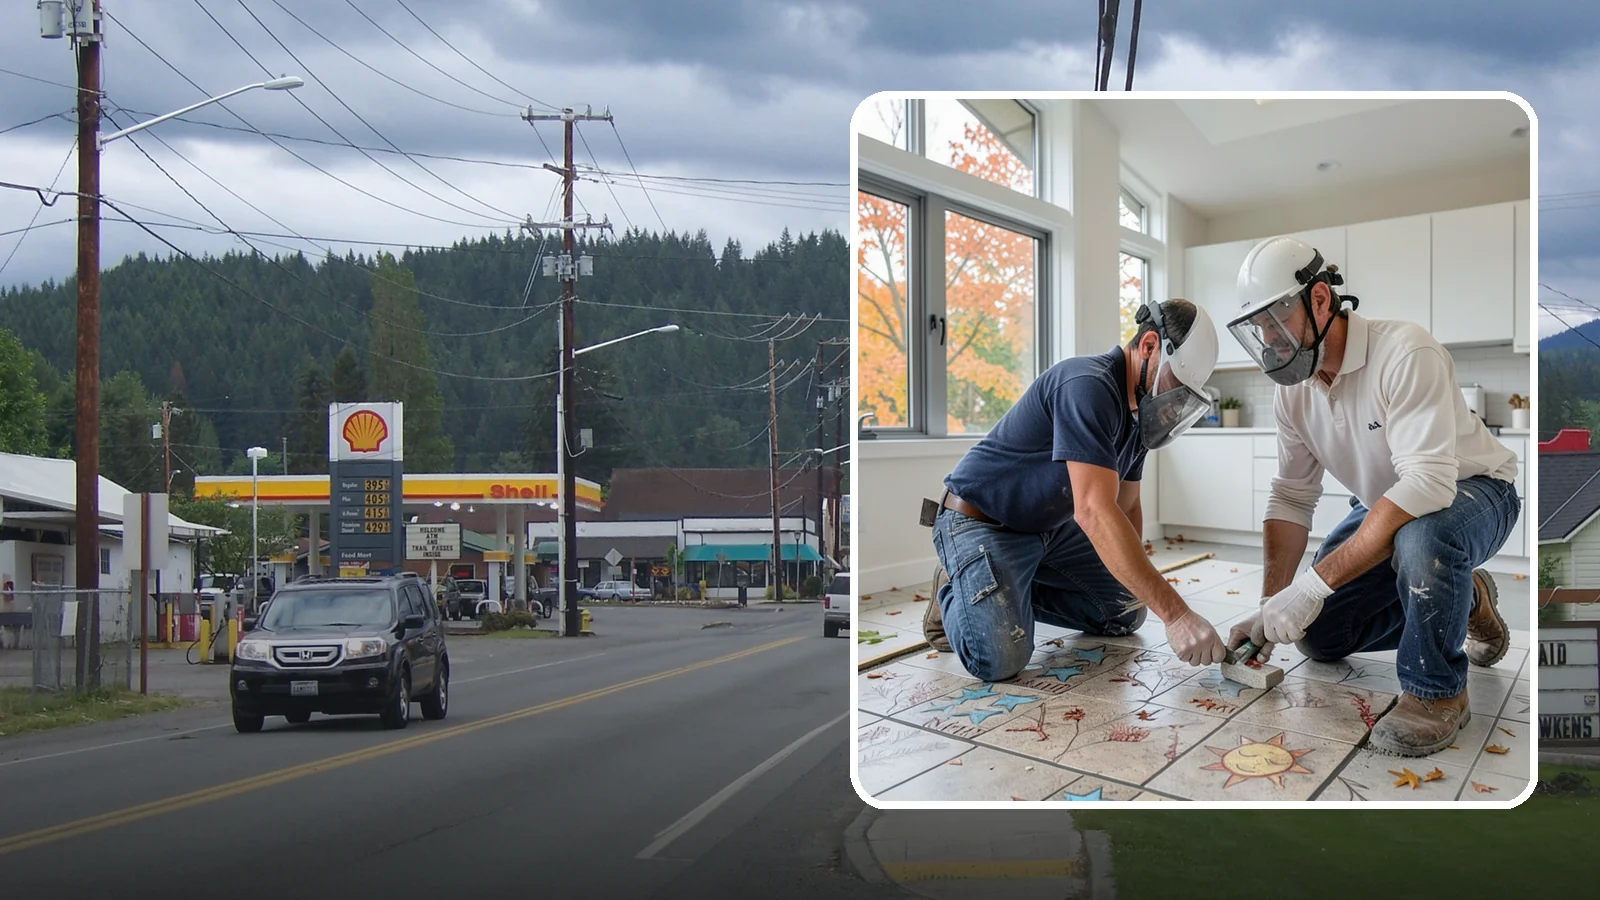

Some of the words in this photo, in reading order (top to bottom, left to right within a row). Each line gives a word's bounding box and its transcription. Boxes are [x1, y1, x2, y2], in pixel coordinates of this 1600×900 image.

[365, 480, 383, 490] 395
[490, 484, 547, 498] Shell
[365, 494, 383, 504] 405
[365, 508, 383, 518] 415
[366, 522, 383, 532] 429
[1538, 643, 1567, 665] AID
